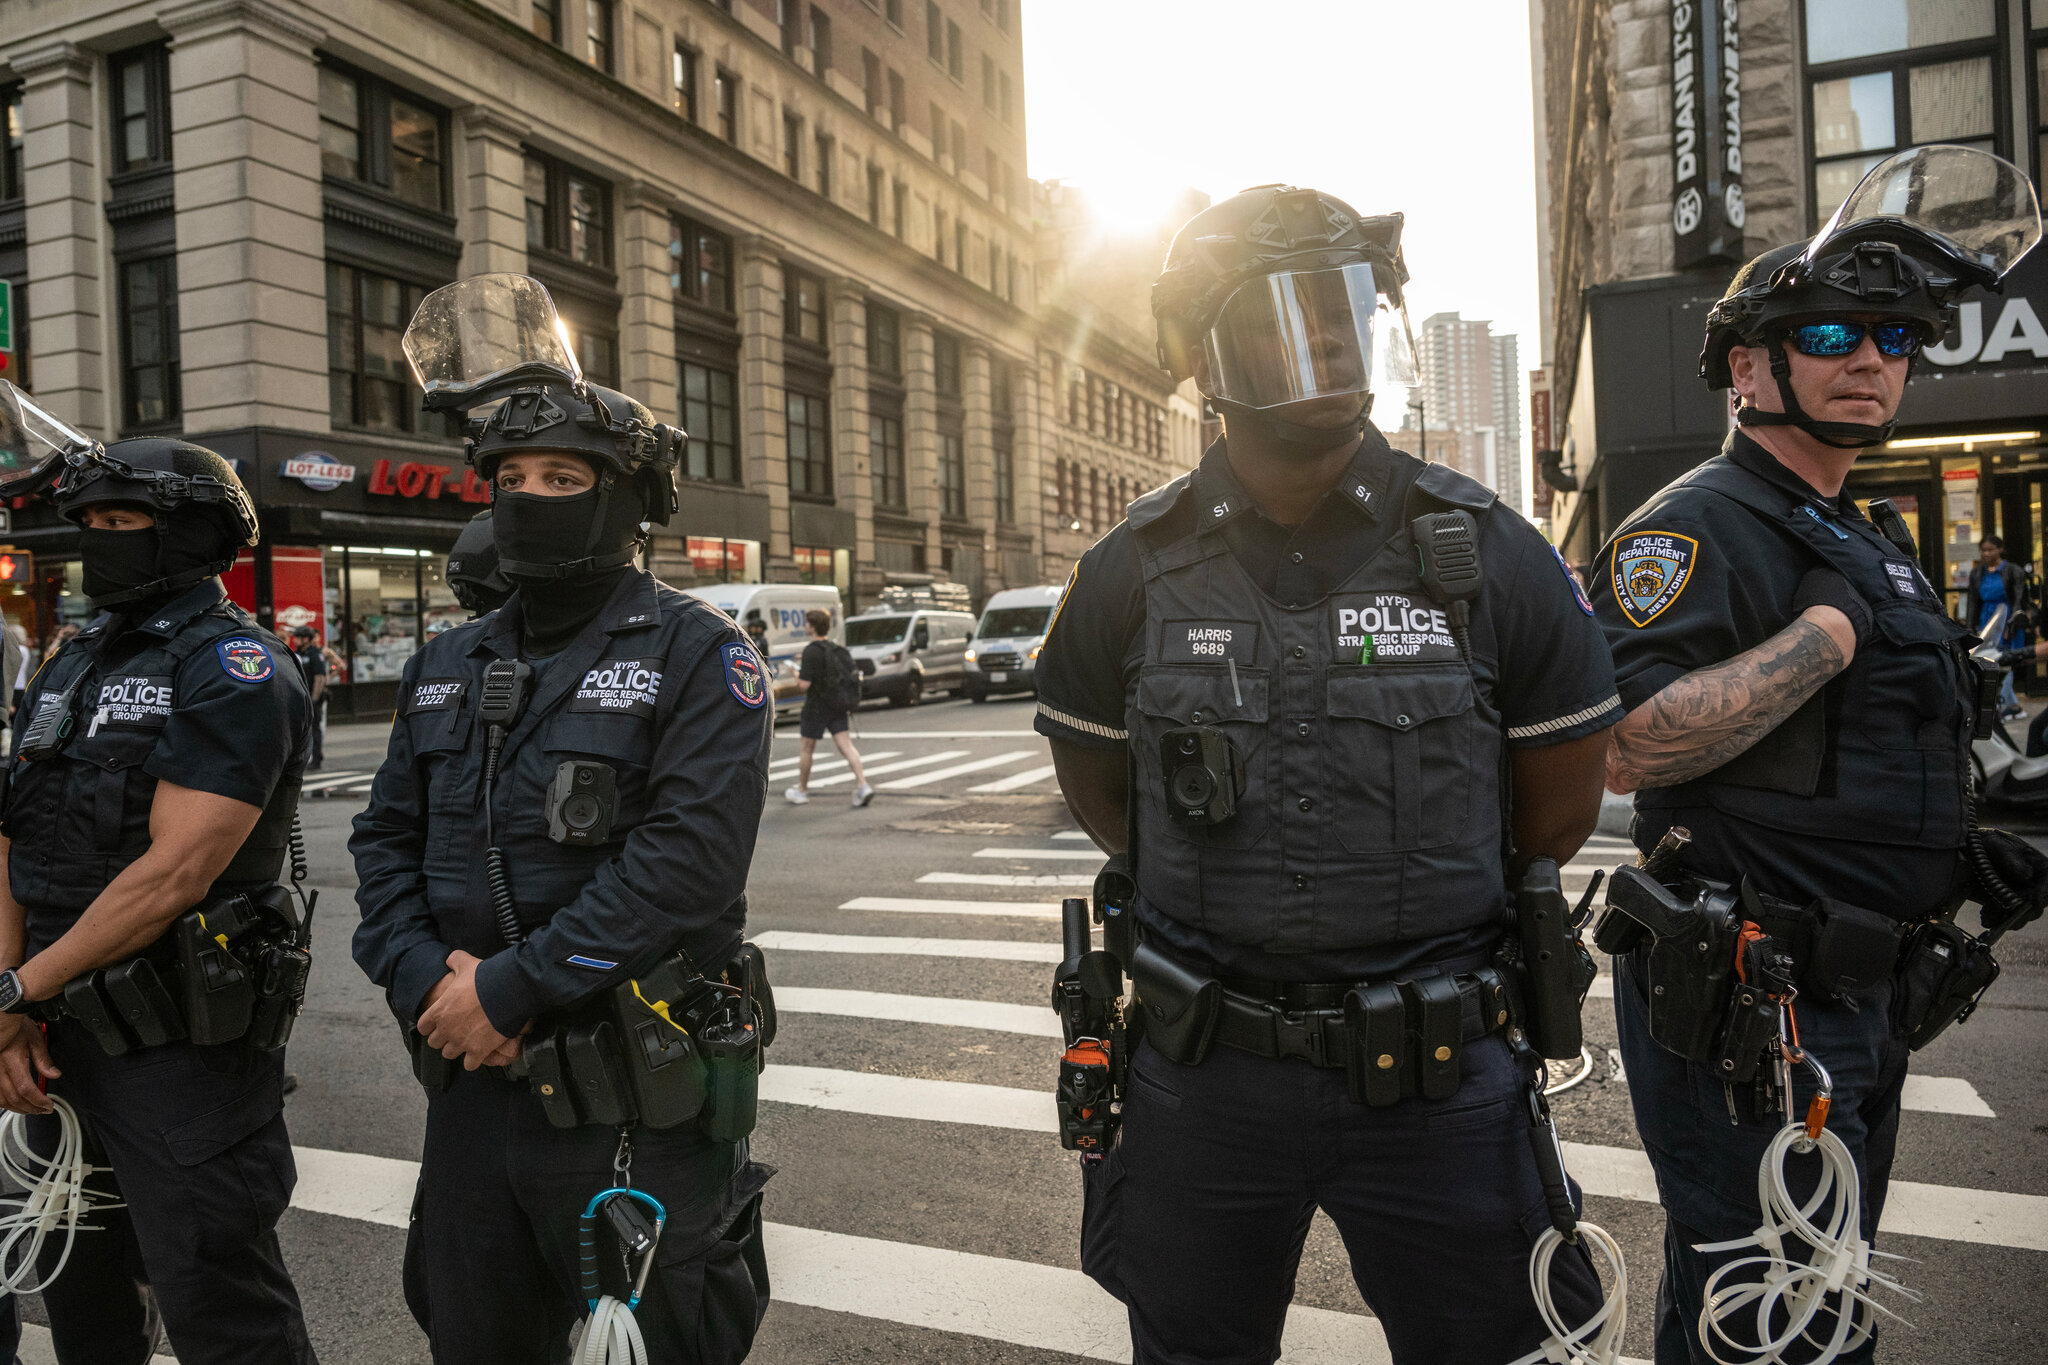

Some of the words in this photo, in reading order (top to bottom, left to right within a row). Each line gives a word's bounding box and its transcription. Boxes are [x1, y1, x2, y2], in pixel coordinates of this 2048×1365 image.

[1355, 485, 1372, 502] S1
[1213, 501, 1229, 518] S1
[1632, 537, 1673, 549] POLICE
[1618, 546, 1687, 562] DEPARTMENT
[1615, 573, 1626, 596] CITY
[1623, 597, 1634, 611] OF
[1647, 595, 1668, 615] NEW
[1665, 568, 1688, 596] YORK
[1375, 596, 1411, 608] NYPD
[155, 620, 170, 629] S2
[628, 615, 645, 623] S2
[1338, 607, 1450, 634] POLICE
[1187, 628, 1232, 642] HARRIS
[1338, 633, 1398, 647] STRAEGIC
[1401, 633, 1455, 647] RESPONSE
[225, 640, 264, 652] POLICE
[1192, 642, 1225, 656] 9689
[1377, 644, 1420, 656] GROUP
[613, 661, 640, 670] NYPD
[123, 677, 149, 686] NYPD
[581, 669, 662, 695] POLICE
[98, 684, 174, 706] POLICE
[416, 683, 461, 696] SANCHEZ
[576, 689, 619, 699] STRATEGIC
[417, 694, 446, 706] 12221
[600, 698, 633, 708] GROUP
[112, 711, 143, 721] GROUP
[130, 704, 173, 716] RESPONSE
